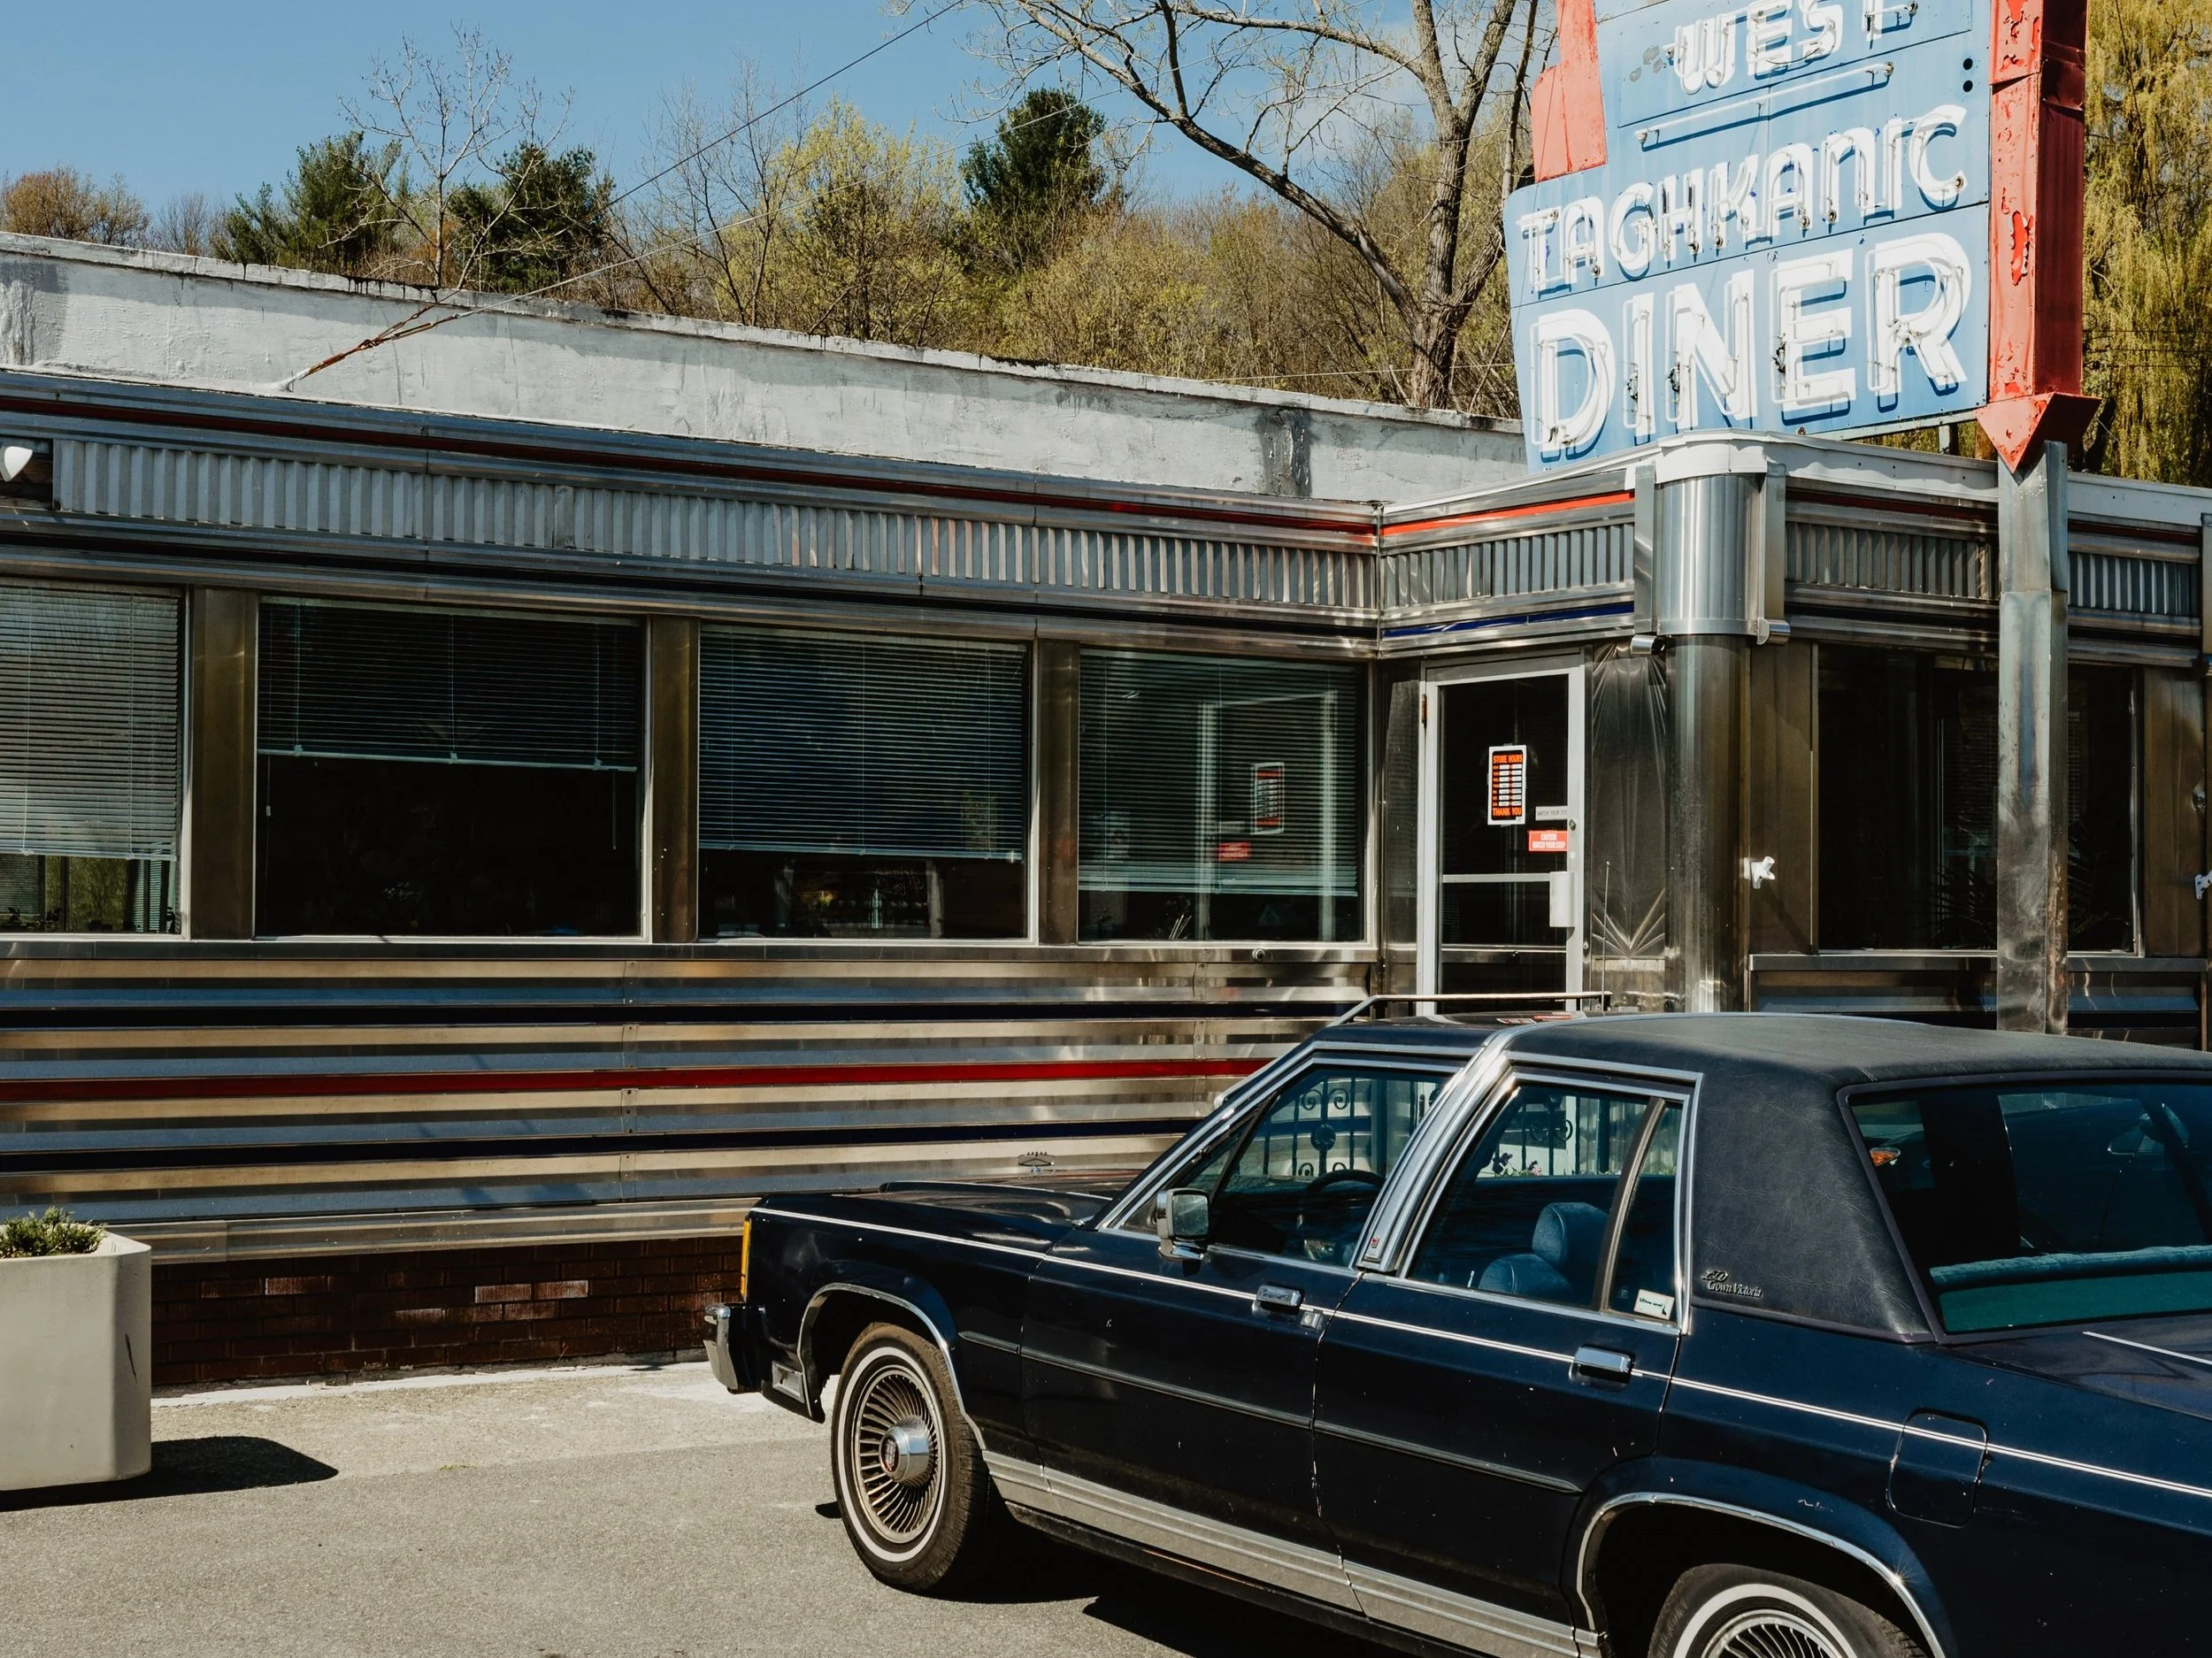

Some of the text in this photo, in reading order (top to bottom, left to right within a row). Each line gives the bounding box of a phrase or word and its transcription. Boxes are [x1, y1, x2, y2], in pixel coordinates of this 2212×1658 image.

[1517, 104, 1967, 294] TAGHKANIC
[1531, 233, 1971, 449] DINER
[1494, 754, 1523, 764] STORE HOURS
[1493, 806, 1522, 817] THANK YOU
[1708, 1280, 1763, 1298] Crown Victoria
